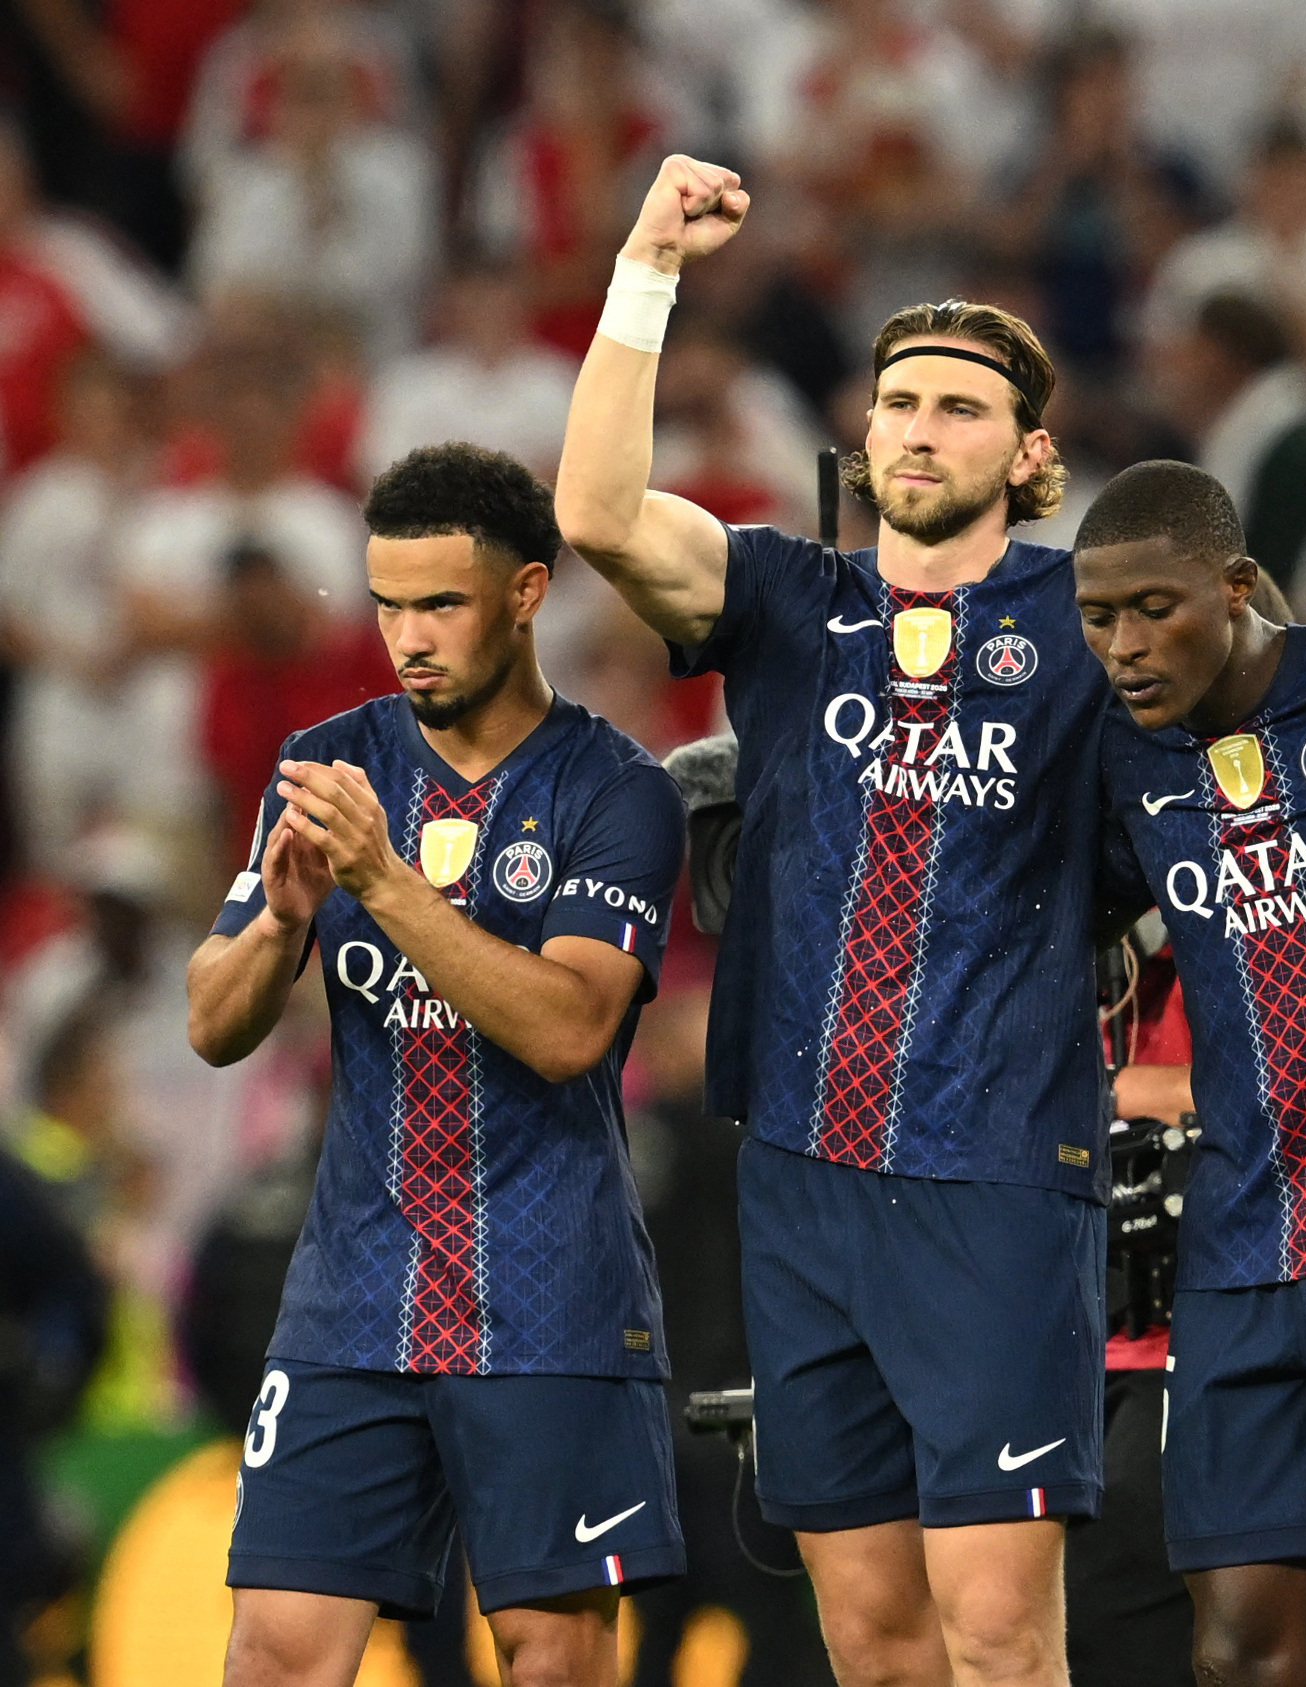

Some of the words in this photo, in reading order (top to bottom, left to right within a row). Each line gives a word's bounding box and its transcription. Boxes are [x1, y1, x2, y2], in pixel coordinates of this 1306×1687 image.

[986, 637, 1027, 652] PARIS
[824, 692, 1018, 774] QATAR
[857, 757, 1016, 810] AIRWAYS
[505, 844, 543, 860] PARIS
[552, 878, 658, 925] EYOND
[244, 1369, 290, 1468] 3
